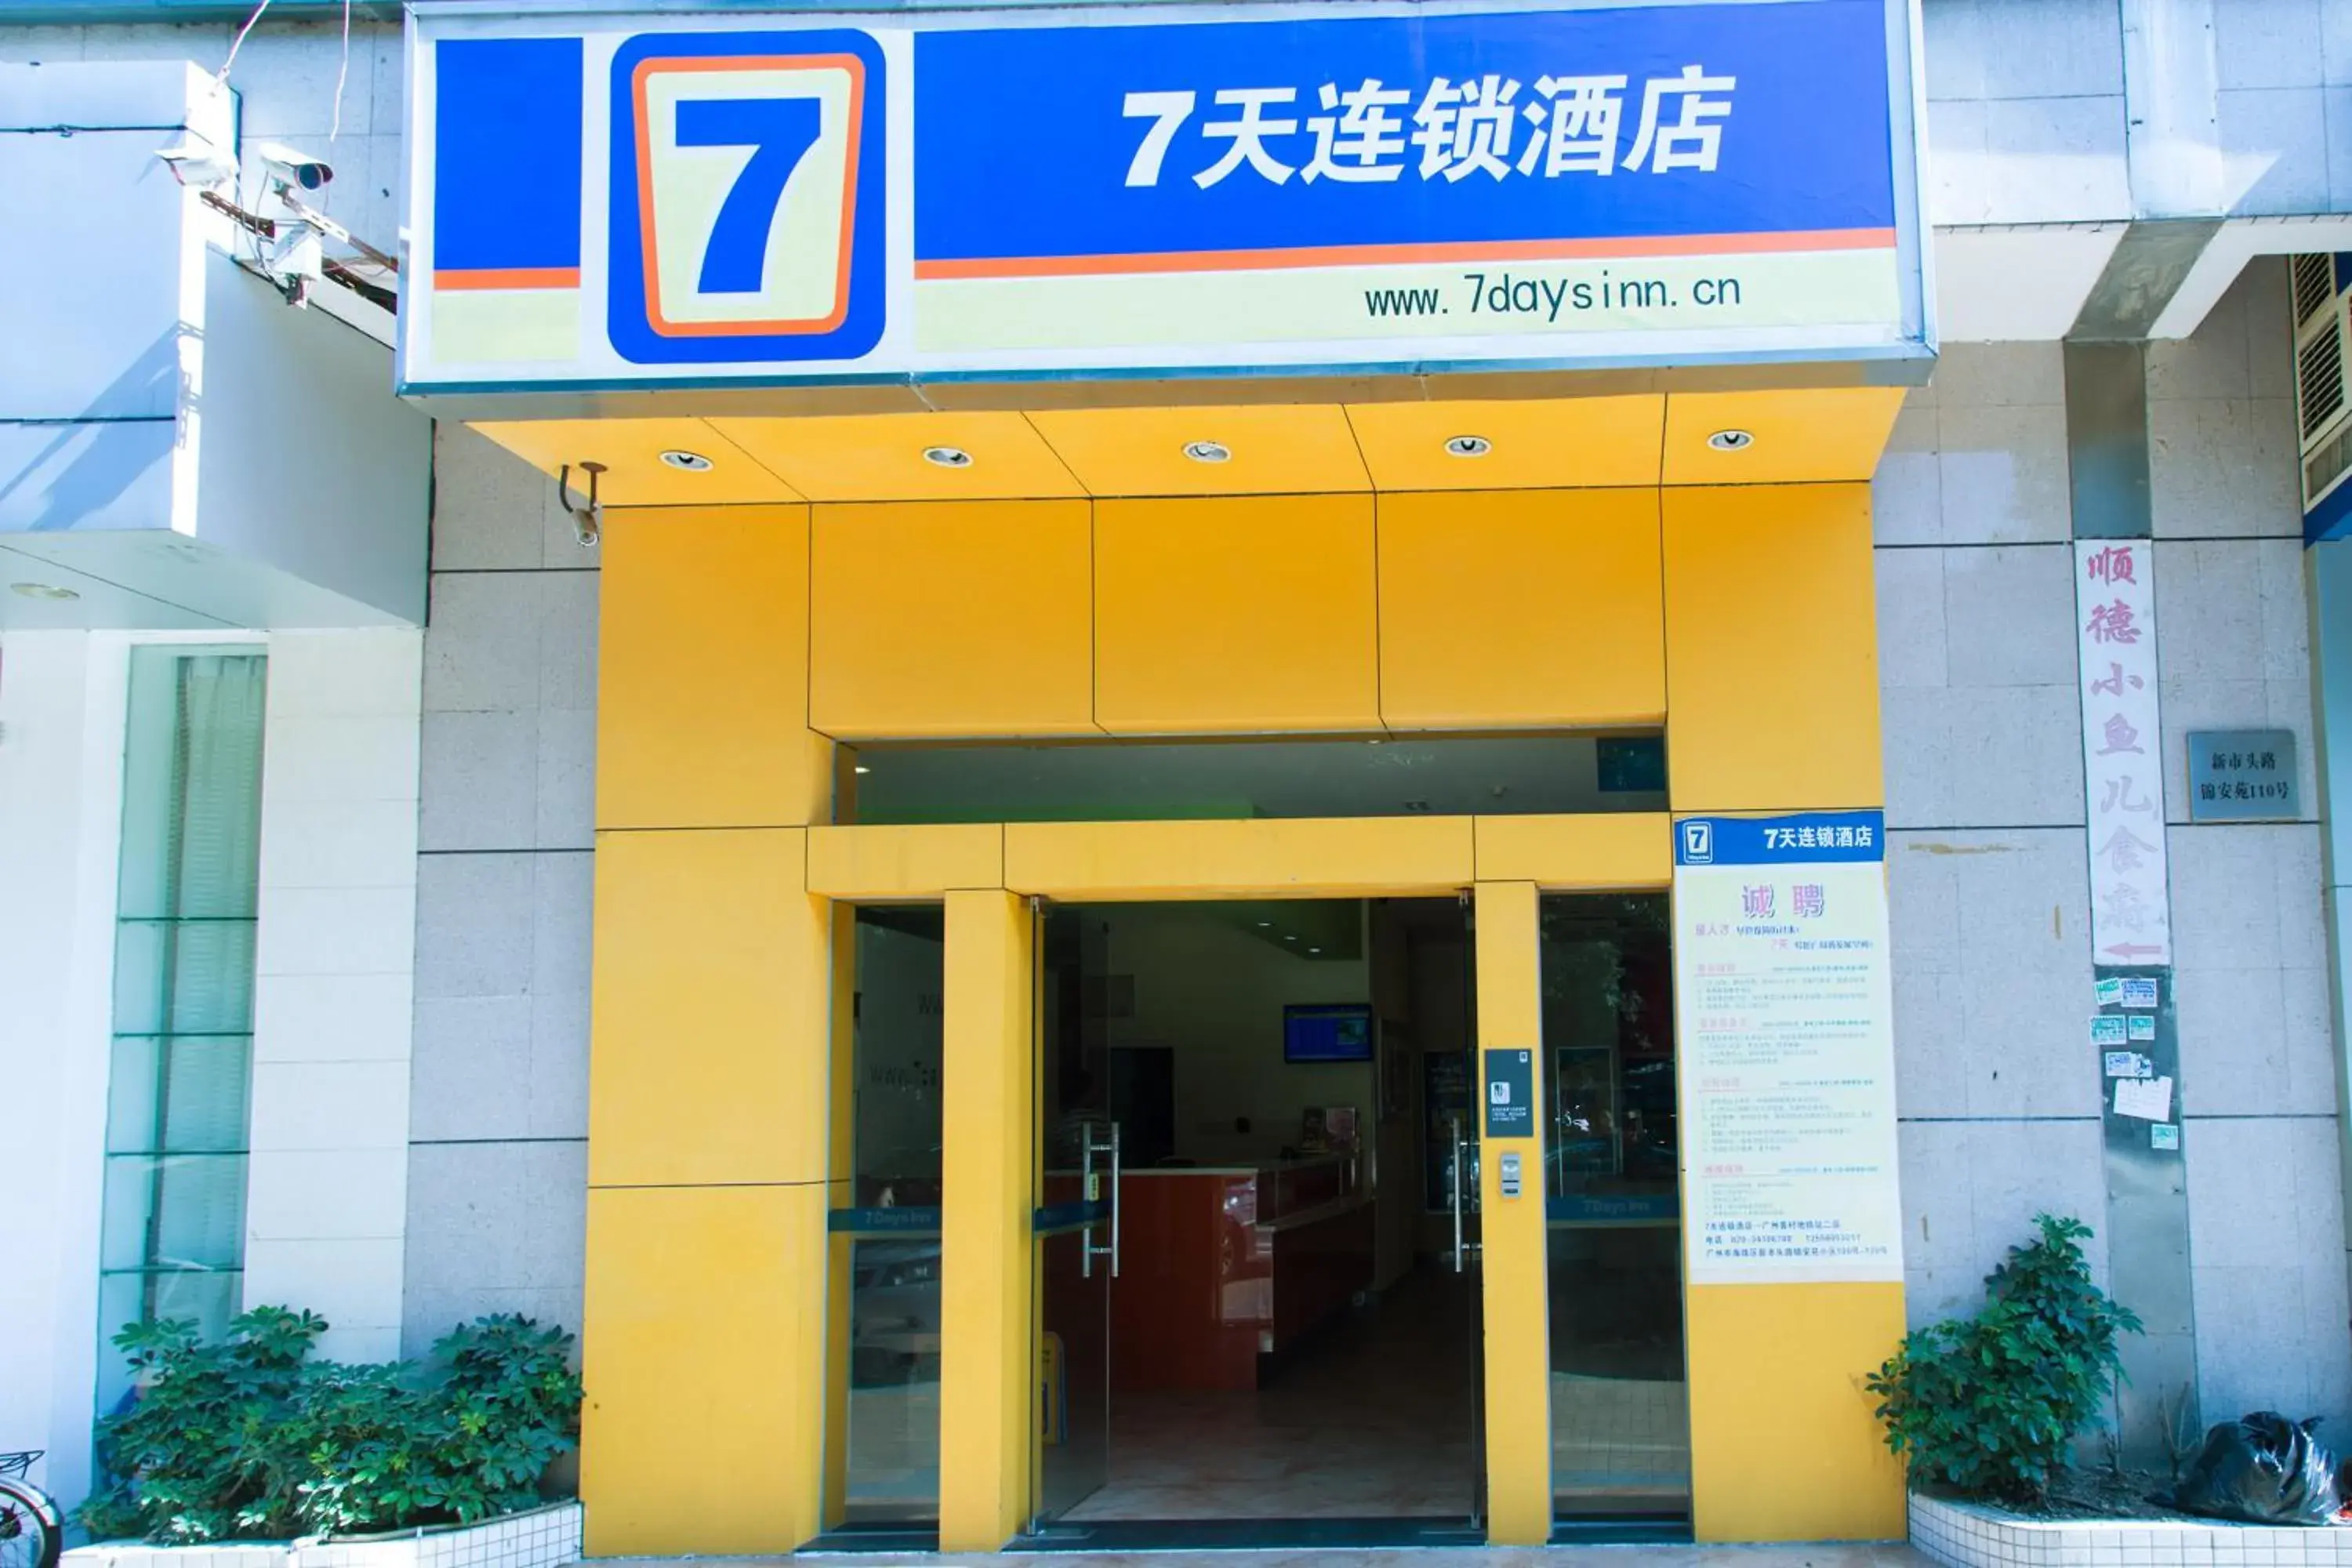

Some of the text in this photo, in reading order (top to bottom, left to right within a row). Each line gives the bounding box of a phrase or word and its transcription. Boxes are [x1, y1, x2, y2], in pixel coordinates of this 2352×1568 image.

[1121, 64, 1736, 189] 7天连锁酒店
[675, 97, 821, 294] 7
[2212, 752, 2275, 771] 新市头路
[1690, 829, 1704, 849] 7
[1764, 826, 1872, 849] 7天连锁酒店
